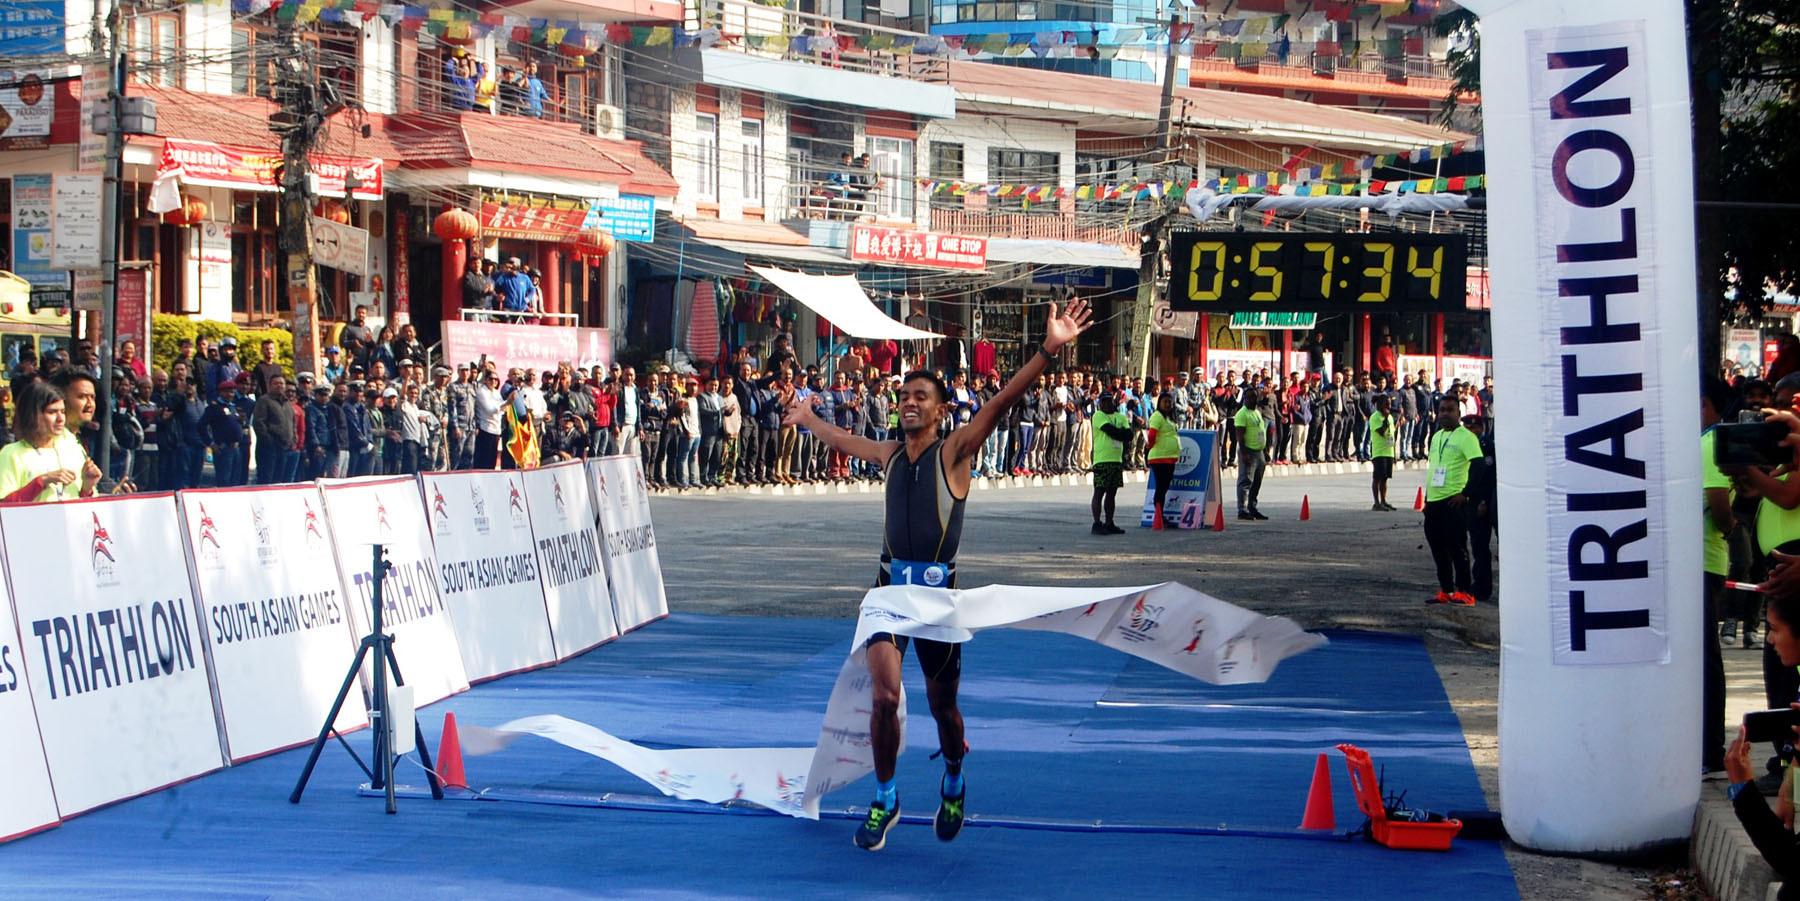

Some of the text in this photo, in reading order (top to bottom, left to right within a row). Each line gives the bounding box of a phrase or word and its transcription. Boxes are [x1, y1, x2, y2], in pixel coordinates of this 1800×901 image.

[941, 238, 960, 252] ONE
[960, 239, 982, 254] STOP
[1188, 242, 1443, 302] 0:57:34
[1546, 46, 1650, 652] TRIATHLON
[1182, 506, 1196, 528] 4
[442, 553, 536, 594] SOUTH ASIAN GAMES
[540, 528, 600, 588] TRIATHLON
[902, 566, 912, 585] 1
[212, 590, 340, 644] SOUTH ASIAN GAMES
[33, 598, 195, 699] TRIATHLON
